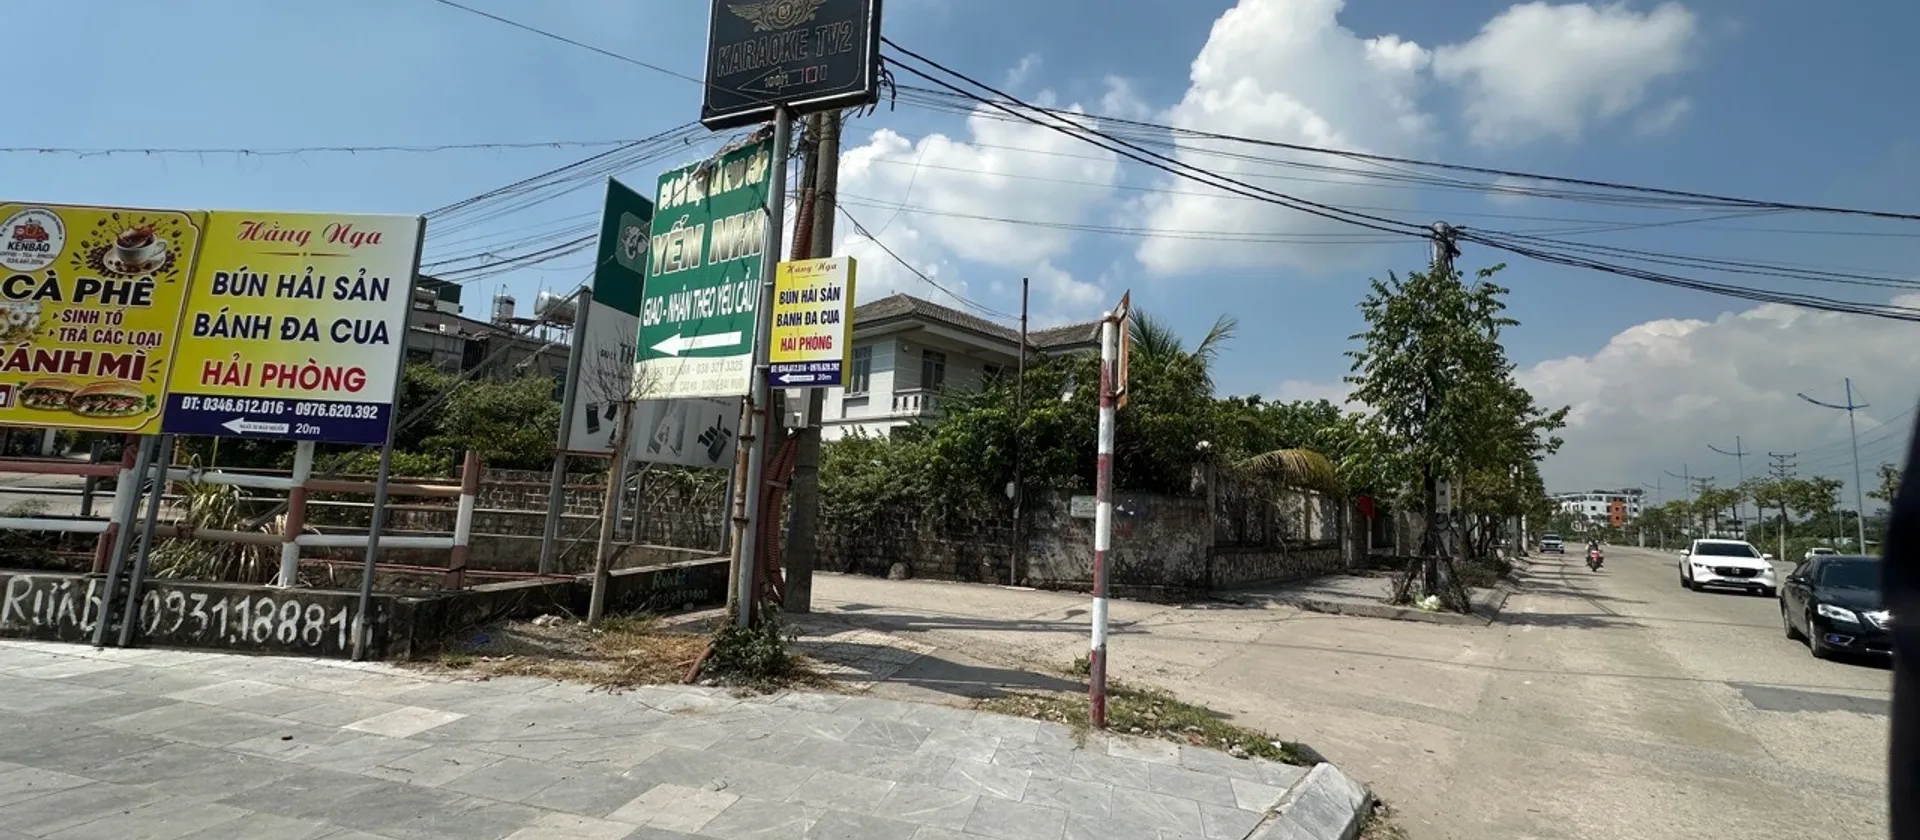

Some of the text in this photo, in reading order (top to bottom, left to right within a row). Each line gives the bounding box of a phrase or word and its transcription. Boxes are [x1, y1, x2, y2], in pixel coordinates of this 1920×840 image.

[716, 19, 854, 77] KARAOKE TV2
[237, 221, 382, 249] Hằng Nga
[652, 214, 705, 277] YẾN
[2, 271, 154, 306] CÀ PHÊ
[212, 266, 390, 301] BÚN HẢI SẢN
[62, 307, 124, 325] SINH TỐ
[643, 296, 663, 326] GIAO
[667, 284, 692, 329] NHẬN
[691, 286, 716, 320] THEO
[820, 308, 840, 324] CUA
[59, 327, 162, 349] TRÀ CÁC LOẠI
[193, 307, 390, 345] BÁNH ĐA CUA
[97, 350, 147, 381] MÌ
[201, 353, 366, 393] HẢI PHÒNG
[182, 396, 200, 410] ĐT:
[203, 398, 284, 415] 0346.612.016
[296, 402, 378, 419] 0976.620.392
[295, 423, 321, 435] 20m
